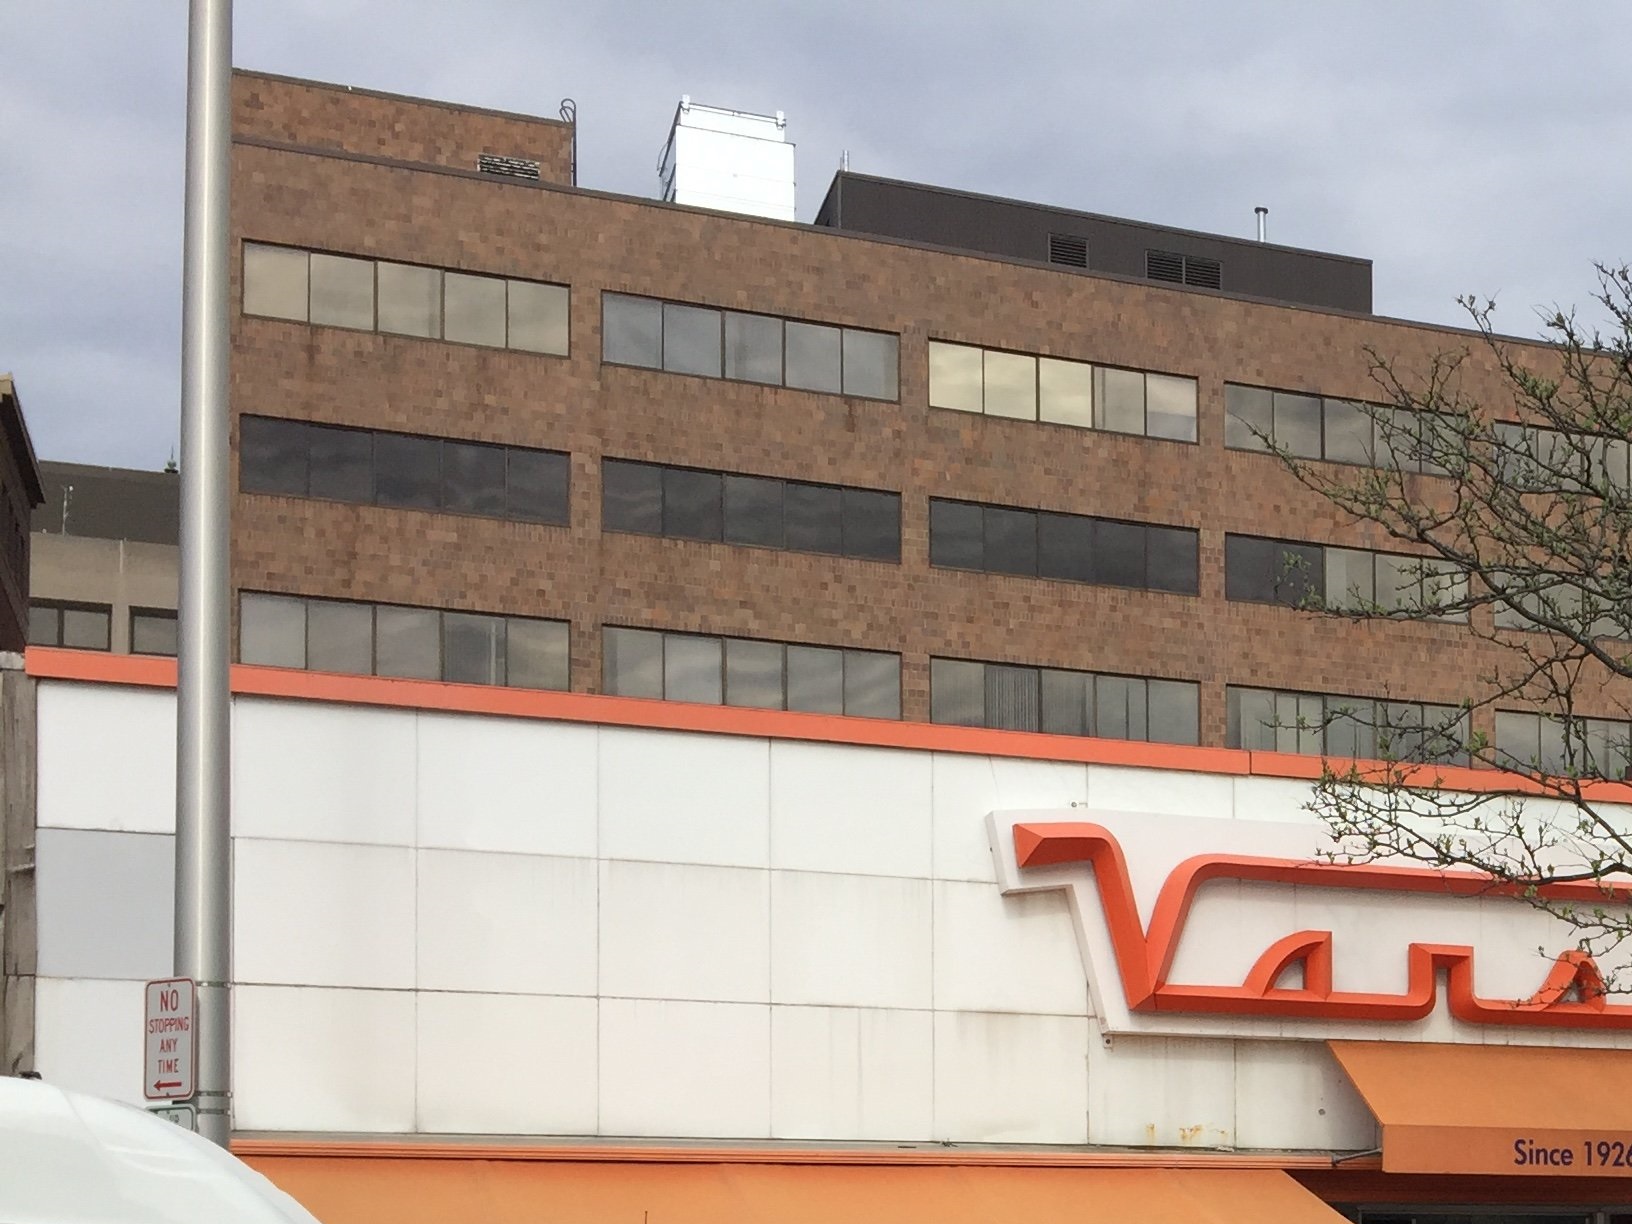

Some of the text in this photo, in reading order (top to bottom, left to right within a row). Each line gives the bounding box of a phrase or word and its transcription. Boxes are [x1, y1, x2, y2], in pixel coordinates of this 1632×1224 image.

[160, 989, 179, 1012] NO
[149, 1016, 190, 1034] STOPPING
[159, 1038, 179, 1053] ANY
[158, 1058, 180, 1074] TIME
[1514, 1139, 1574, 1166] Since
